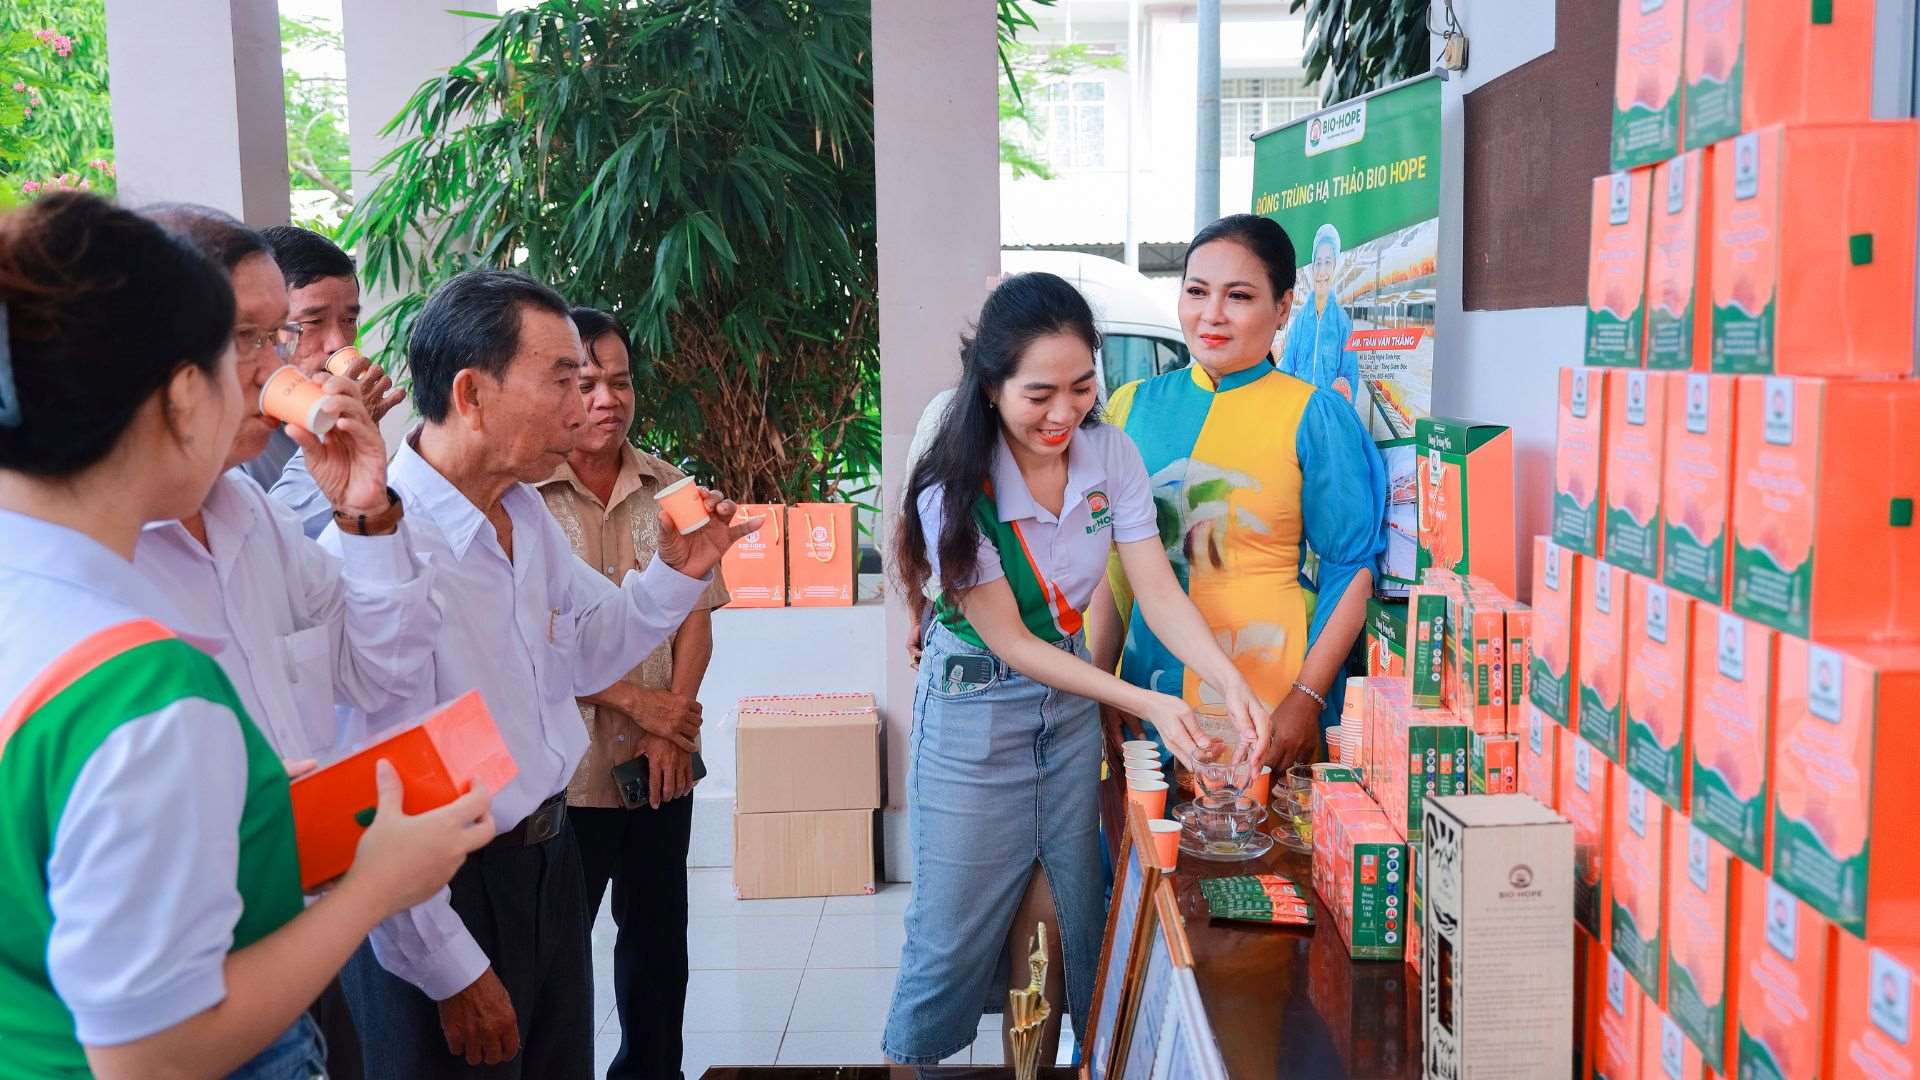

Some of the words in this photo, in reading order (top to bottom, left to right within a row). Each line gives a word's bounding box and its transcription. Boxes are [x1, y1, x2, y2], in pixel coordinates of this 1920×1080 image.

[1315, 179, 1330, 204] HẠ
[1333, 166, 1364, 197] THẢO
[1366, 165, 1387, 190] BIO
[1390, 155, 1427, 184] HOPE
